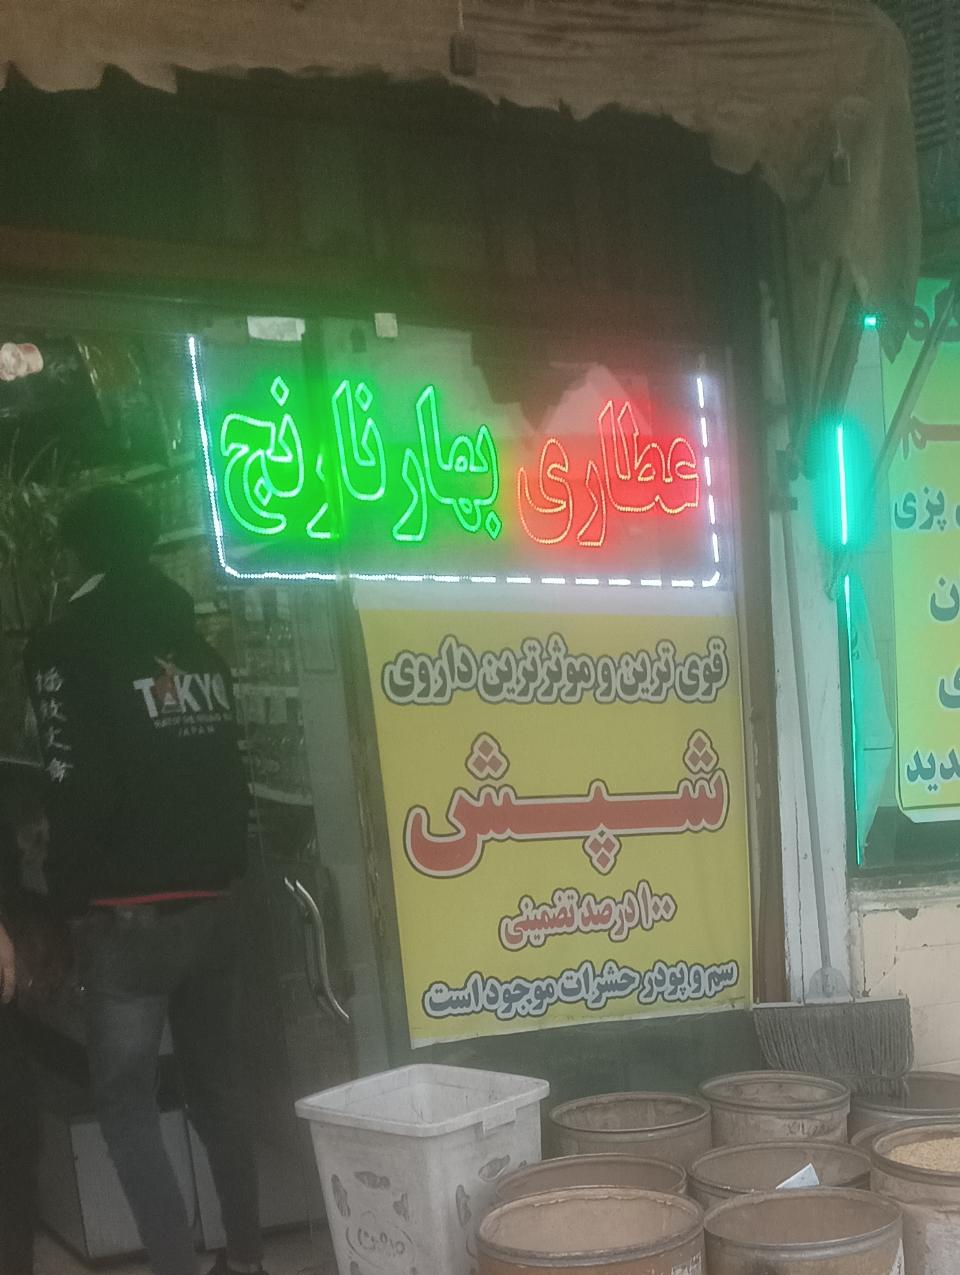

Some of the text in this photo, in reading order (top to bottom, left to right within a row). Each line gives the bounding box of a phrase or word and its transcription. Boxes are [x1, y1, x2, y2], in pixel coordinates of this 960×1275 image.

[517, 399, 699, 546] عطاری
[895, 484, 945, 531] پزی
[383, 635, 477, 704] داروی
[596, 655, 617, 703] و
[616, 640, 676, 703] ترین
[676, 637, 727, 702] قوی
[404, 730, 729, 878] شپش
[500, 880, 676, 951] ۱۰۰ درصد تضمینی
[424, 959, 738, 1020] سم و پودر حشرات موجود است
